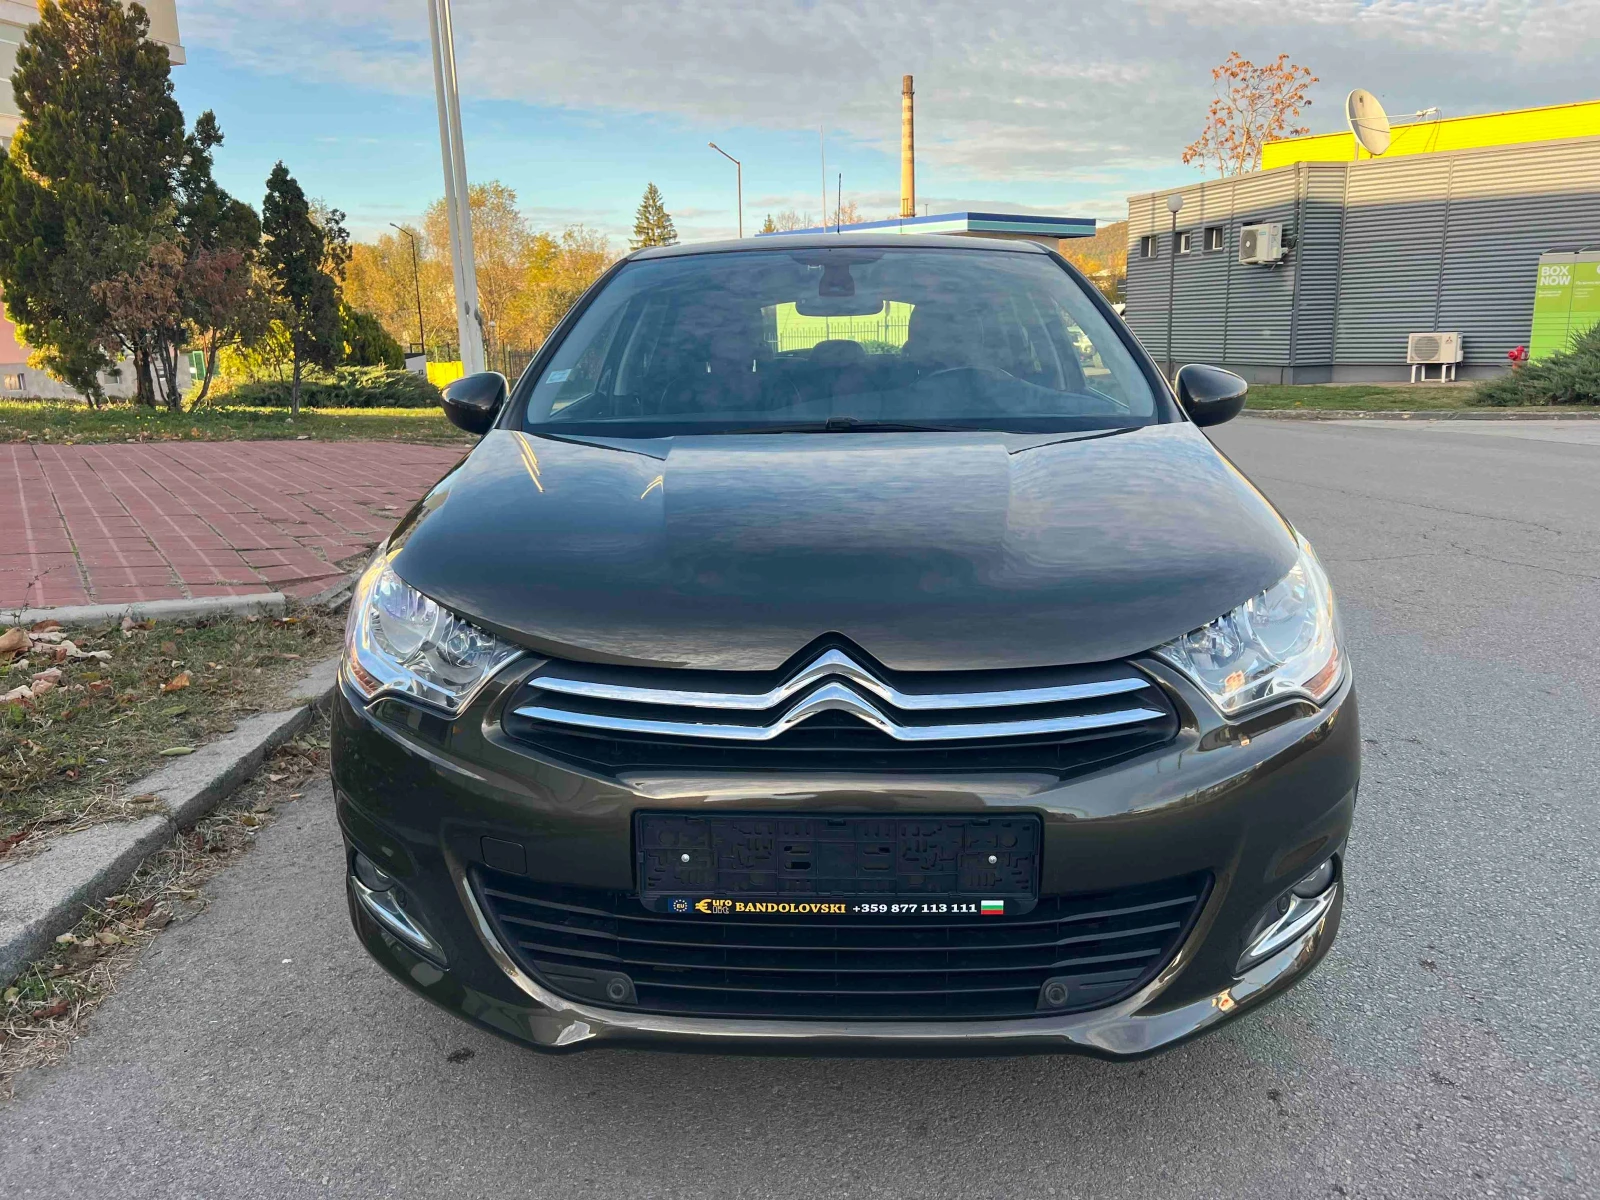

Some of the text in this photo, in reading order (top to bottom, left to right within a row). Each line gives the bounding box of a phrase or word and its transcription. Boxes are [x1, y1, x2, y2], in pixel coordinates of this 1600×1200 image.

[1541, 265, 1570, 276] BOX
[1540, 275, 1571, 286] NOW
[735, 902, 977, 913] BANDOLOVSKI +359 877 113 111
